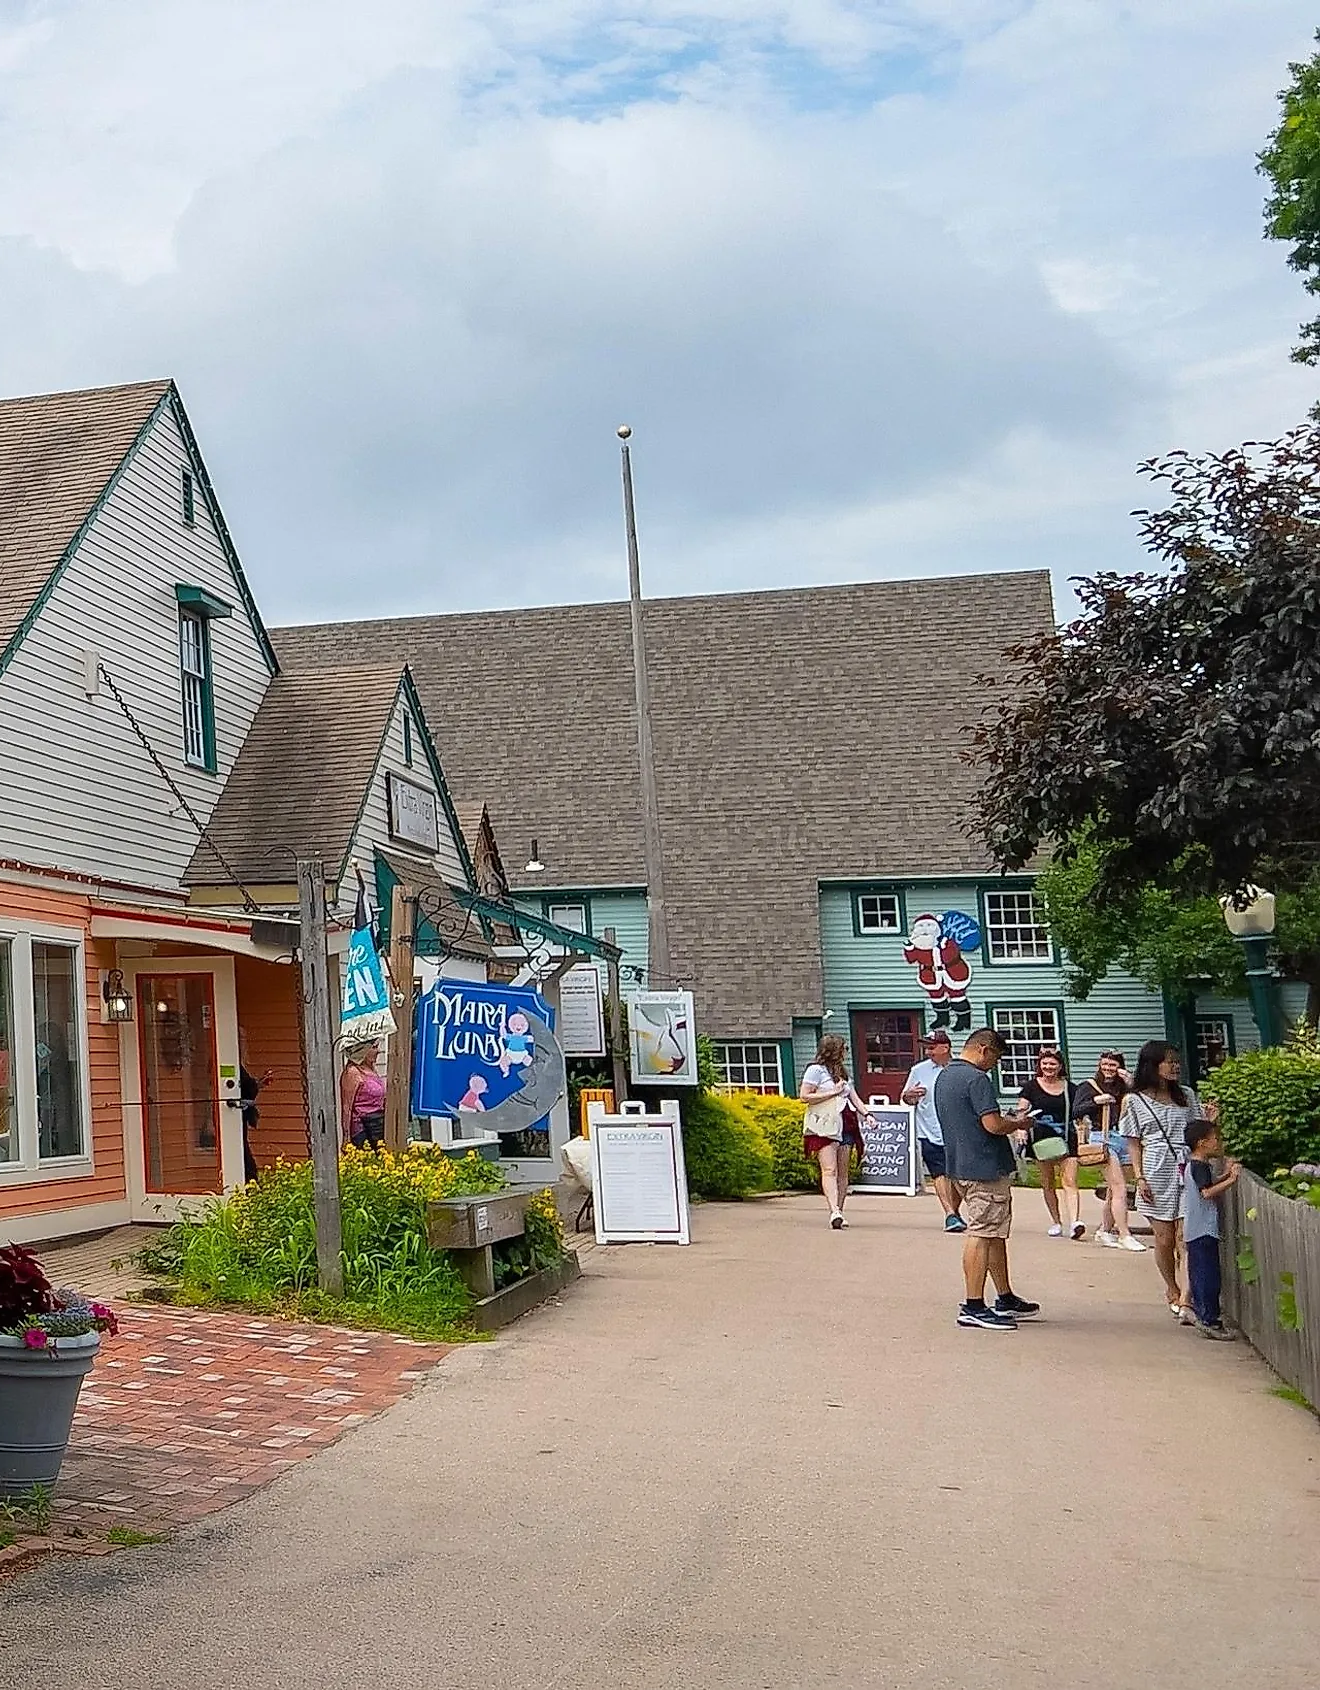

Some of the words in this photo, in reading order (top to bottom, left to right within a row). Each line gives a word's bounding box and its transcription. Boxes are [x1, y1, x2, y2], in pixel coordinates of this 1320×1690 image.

[865, 1143, 900, 1153] ONEY
[861, 1155, 905, 1166] ASTING
[862, 1166, 898, 1175] ROOM
